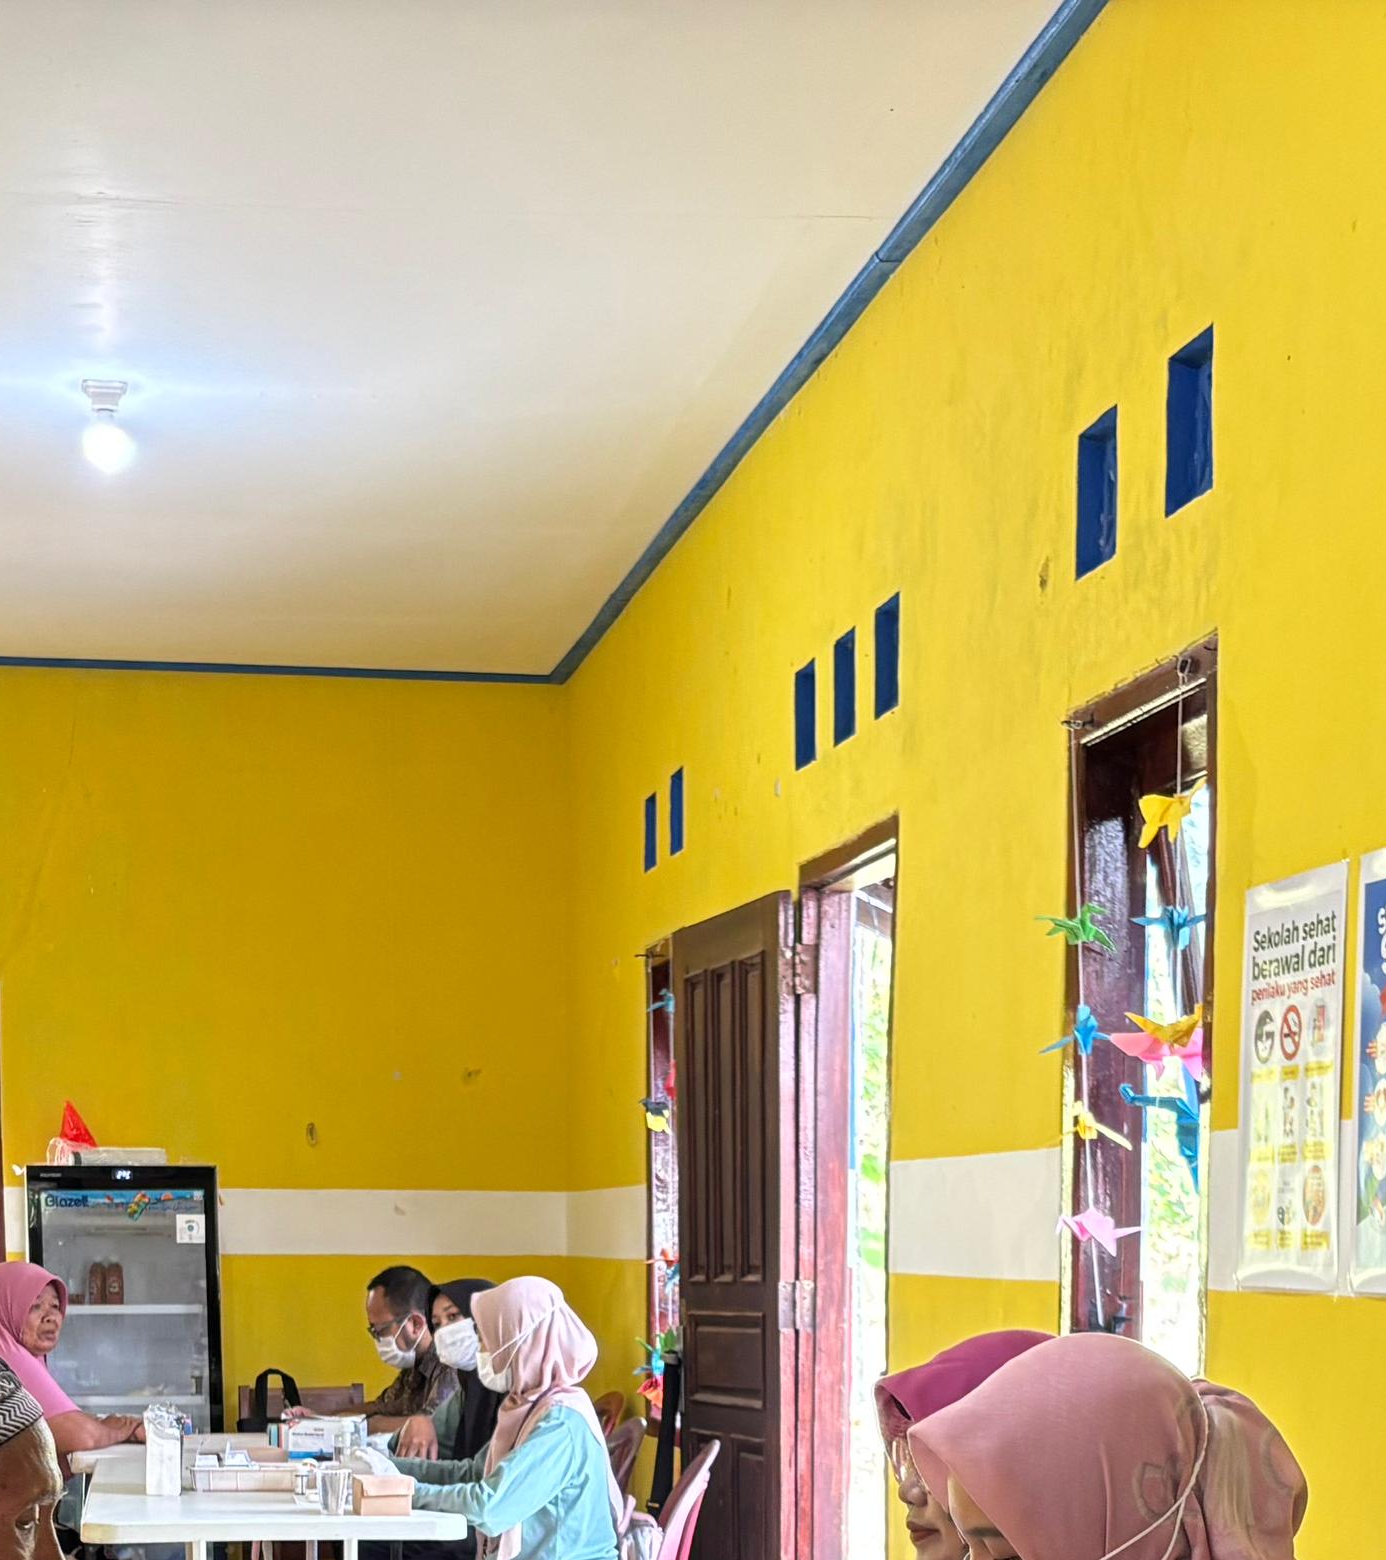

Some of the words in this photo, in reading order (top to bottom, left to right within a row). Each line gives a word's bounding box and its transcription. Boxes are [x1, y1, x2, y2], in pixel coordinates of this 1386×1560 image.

[1253, 920, 1299, 952] Sekolah
[1302, 910, 1336, 941] sehat
[1253, 944, 1305, 981] berawal
[1308, 935, 1336, 969] dari
[1287, 979, 1308, 999] yang
[1310, 969, 1335, 990] sehat
